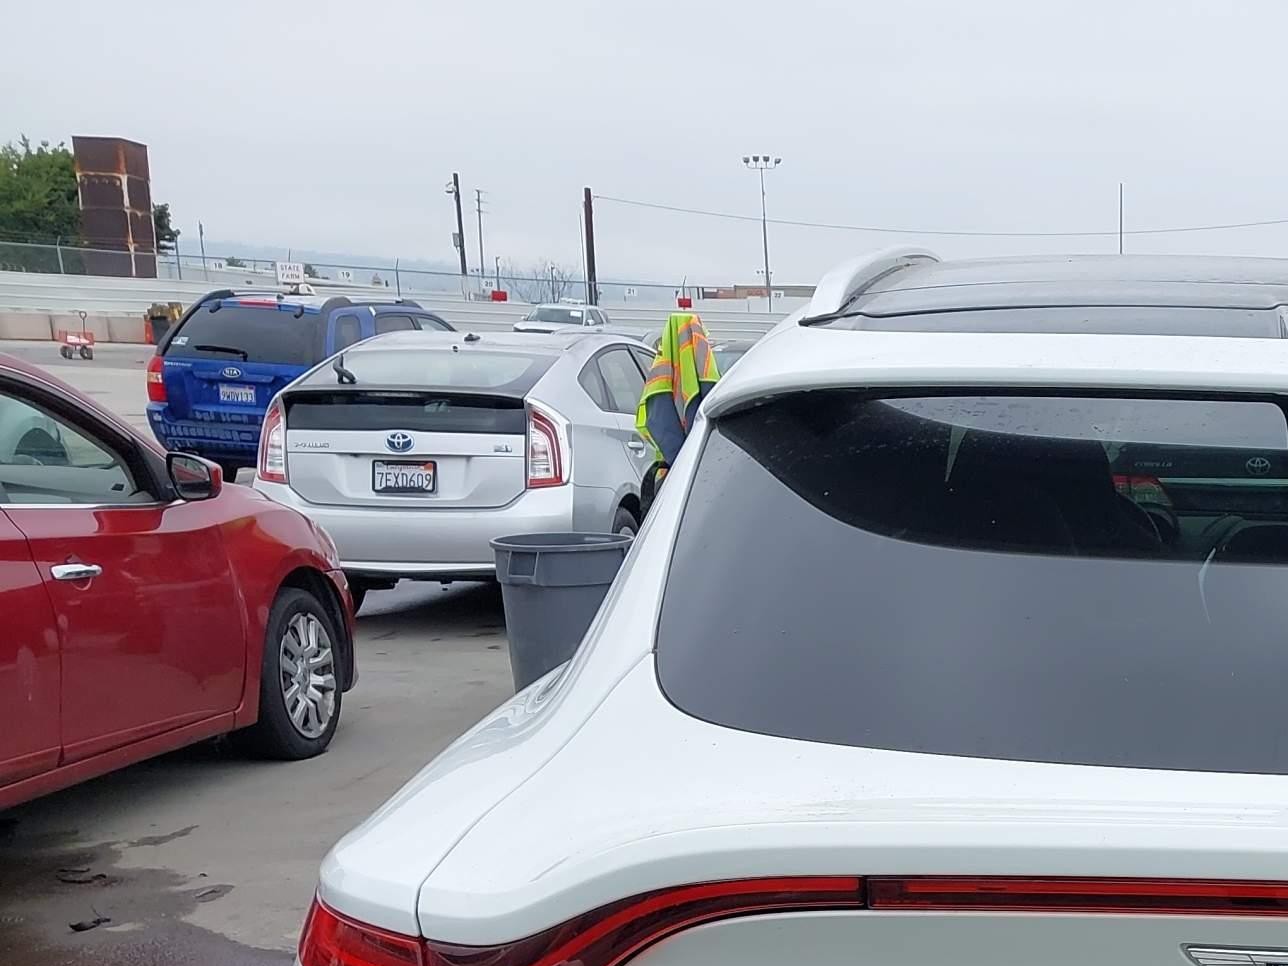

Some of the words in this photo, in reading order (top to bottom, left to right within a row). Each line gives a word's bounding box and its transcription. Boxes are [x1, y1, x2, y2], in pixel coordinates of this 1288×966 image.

[280, 264, 300, 272] STATE
[281, 272, 300, 280] FARM
[341, 271, 350, 279] 19
[225, 368, 239, 376] KIA
[377, 472, 432, 489] 7EXD609
